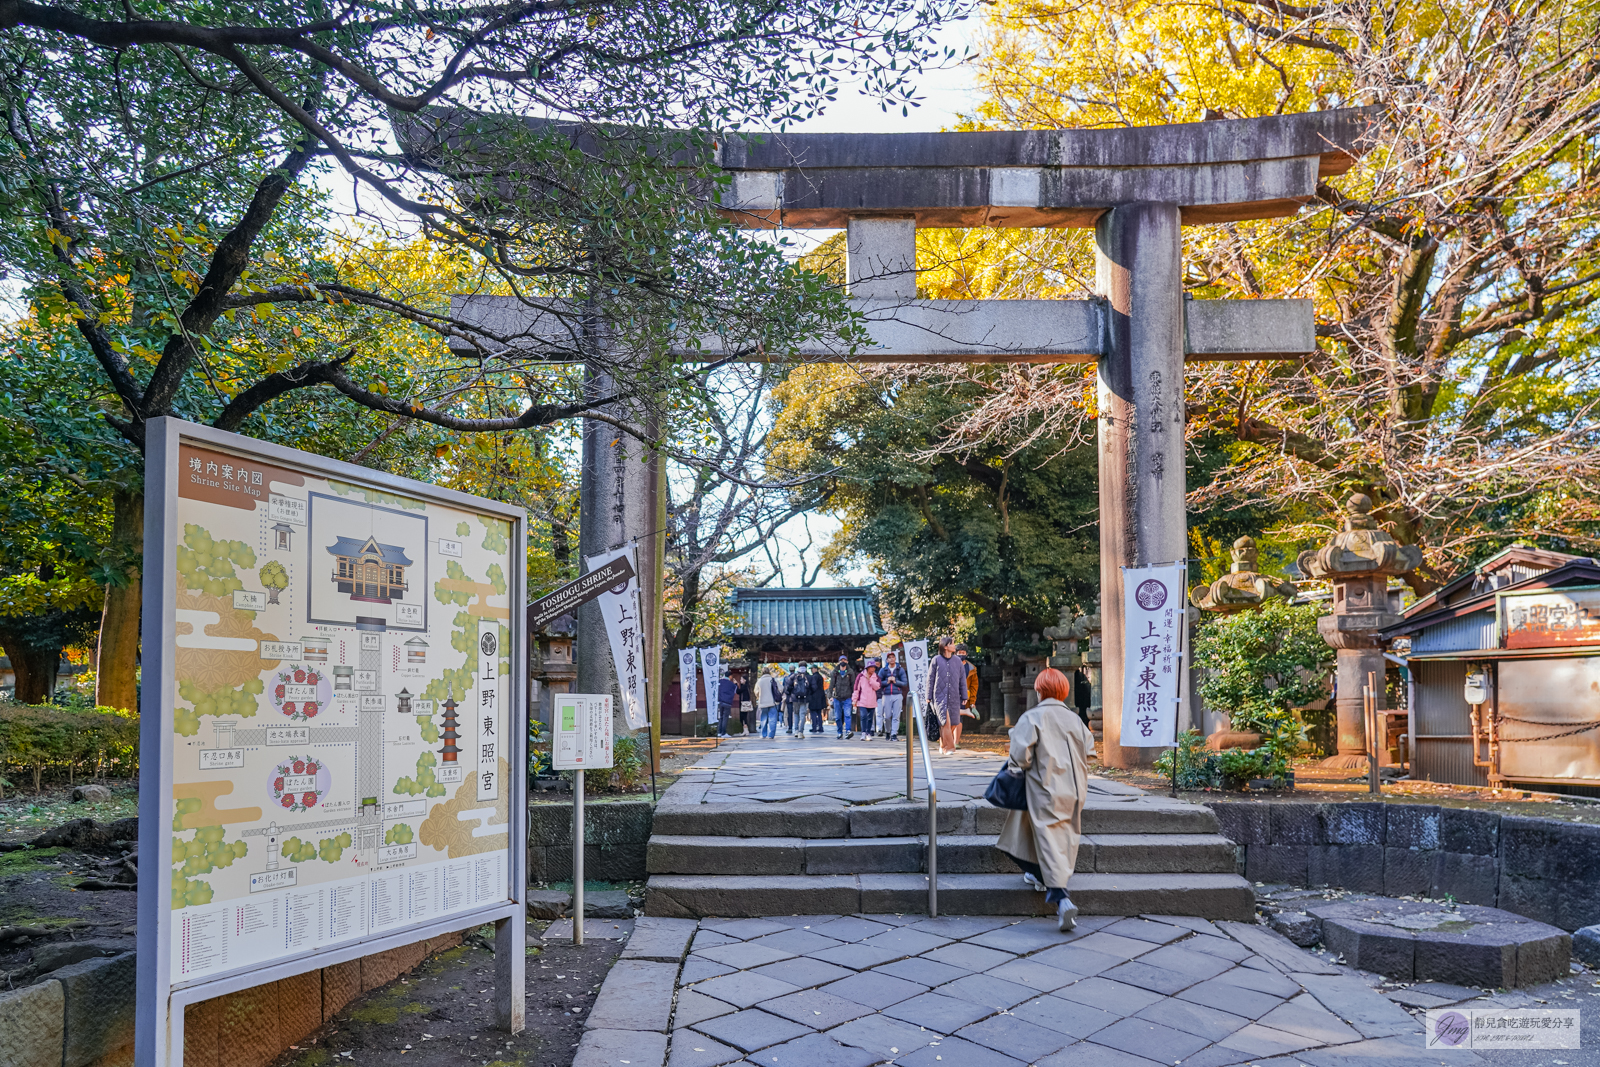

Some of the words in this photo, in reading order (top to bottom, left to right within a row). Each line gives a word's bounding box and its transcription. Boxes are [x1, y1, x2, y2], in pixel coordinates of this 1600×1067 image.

[189, 457, 263, 485] 境内案内図
[190, 474, 220, 488] Shrine
[223, 481, 240, 492] Site
[243, 486, 261, 497] Map
[540, 583, 581, 611] TOSHOGU
[581, 566, 613, 589] SHRINE
[1136, 620, 1161, 738] 上野東照宮
[481, 661, 495, 791] 上野東照宮
[202, 750, 241, 761] 不忍口鳥居
